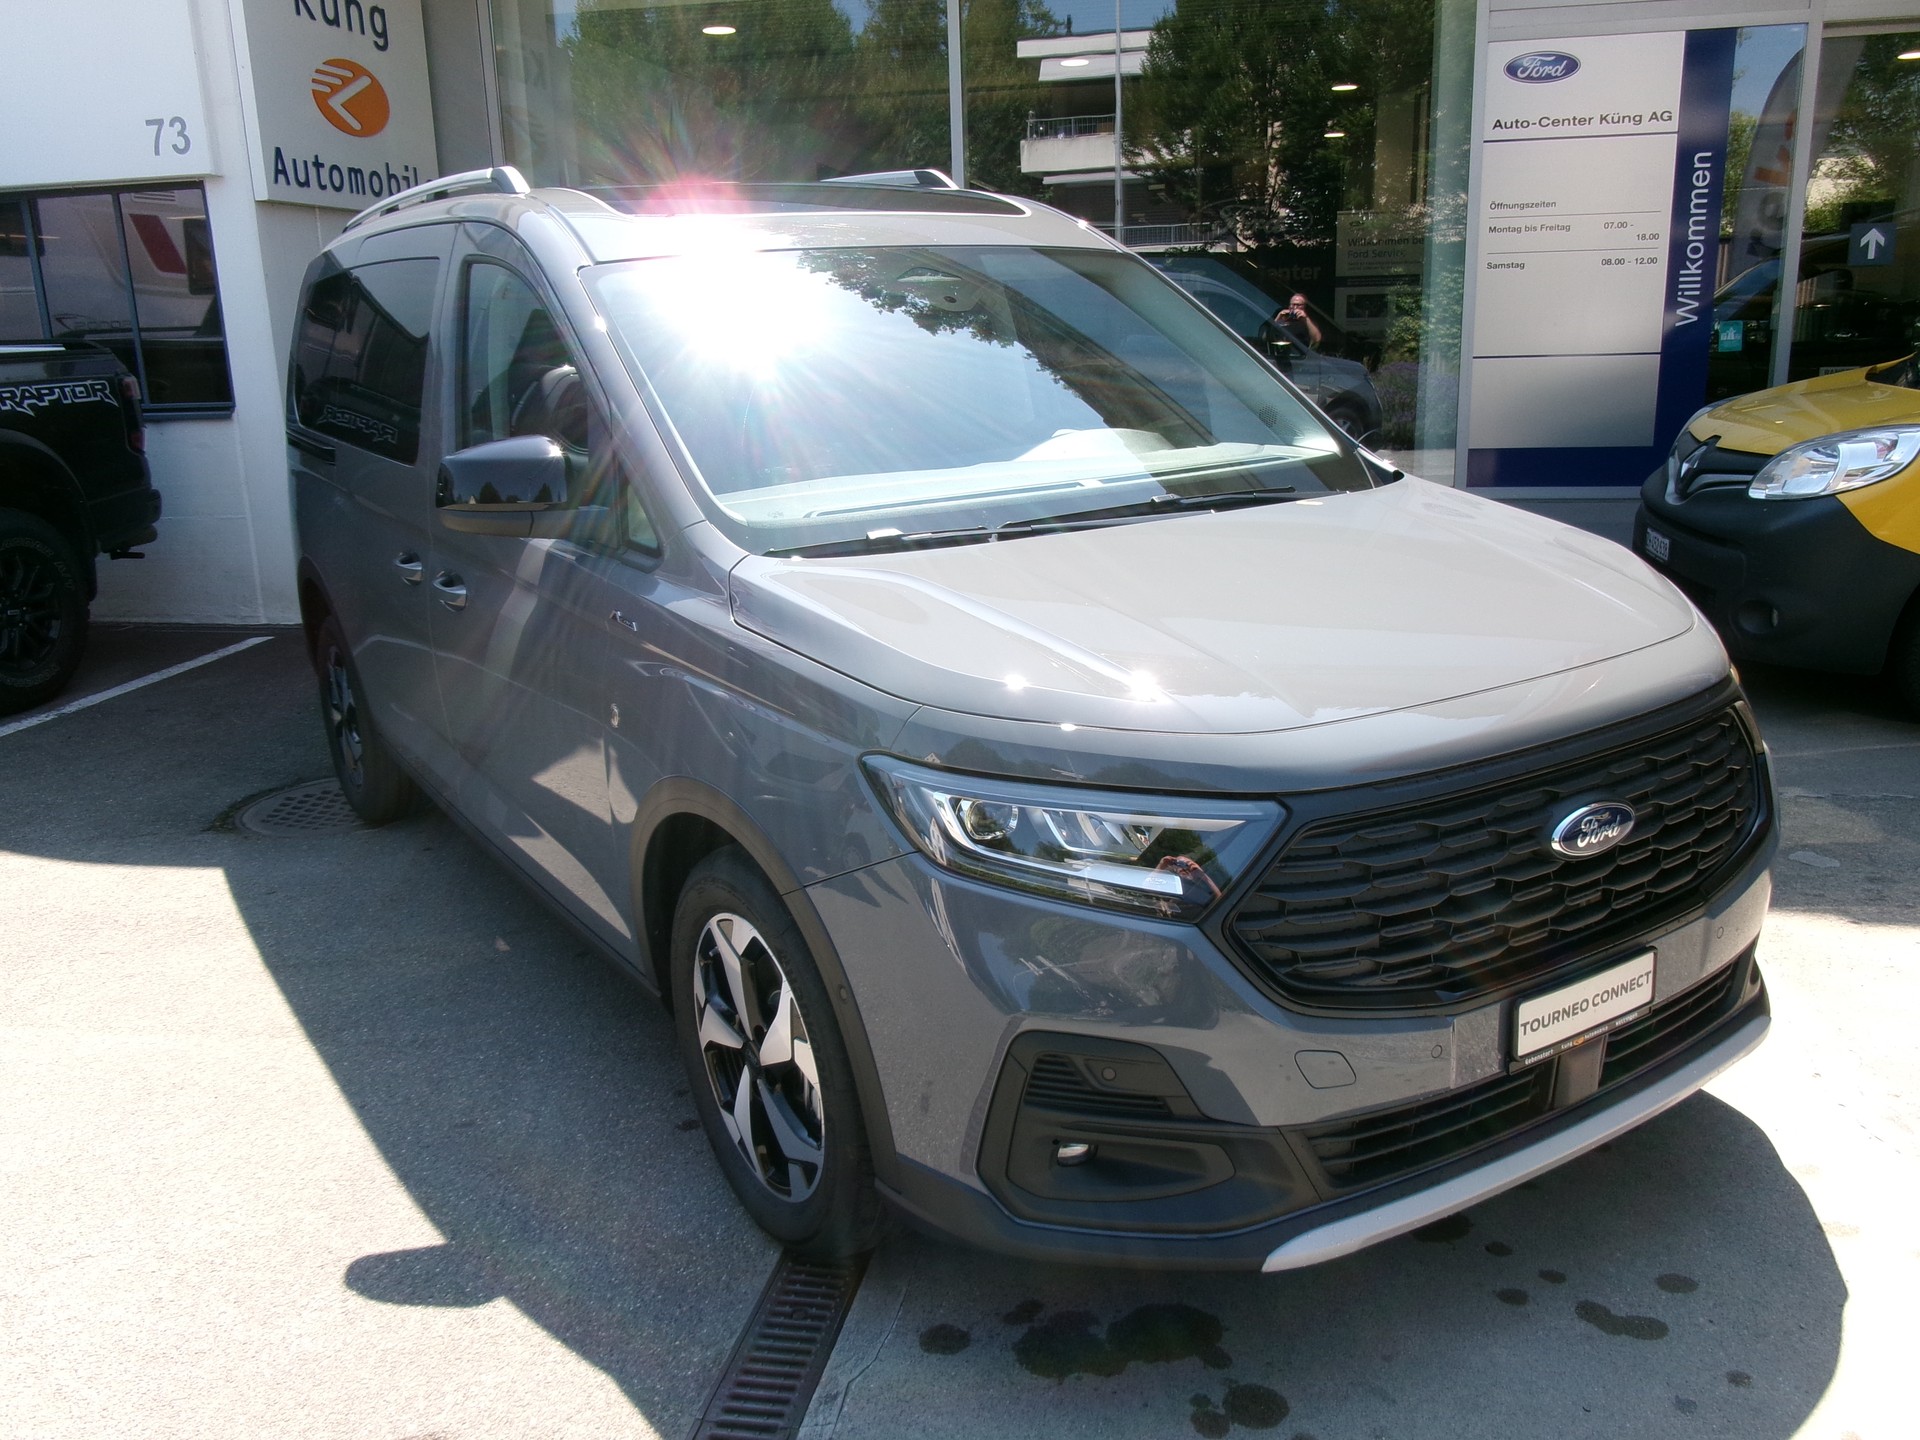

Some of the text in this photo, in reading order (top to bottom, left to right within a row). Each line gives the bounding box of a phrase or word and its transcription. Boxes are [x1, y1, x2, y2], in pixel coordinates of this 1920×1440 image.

[1491, 110, 1673, 131] Auto-Center Küng AG
[145, 116, 191, 157] 73
[272, 147, 434, 198] Automobil
[1489, 200, 1557, 211] Öffnungszeiten
[1488, 225, 1522, 235] Montag
[1524, 224, 1538, 233] bis
[1540, 223, 1571, 233] Freitag
[1603, 221, 1628, 230] 07.00
[1636, 232, 1660, 241] 18.00
[1675, 151, 1712, 327] Willkommen
[1486, 261, 1526, 271] Samstag
[1601, 257, 1626, 266] 08.00
[1634, 256, 1658, 265] 12.00
[0, 380, 119, 416] RAPTOR
[1520, 970, 1652, 1037] TOURNEO CONNECT
